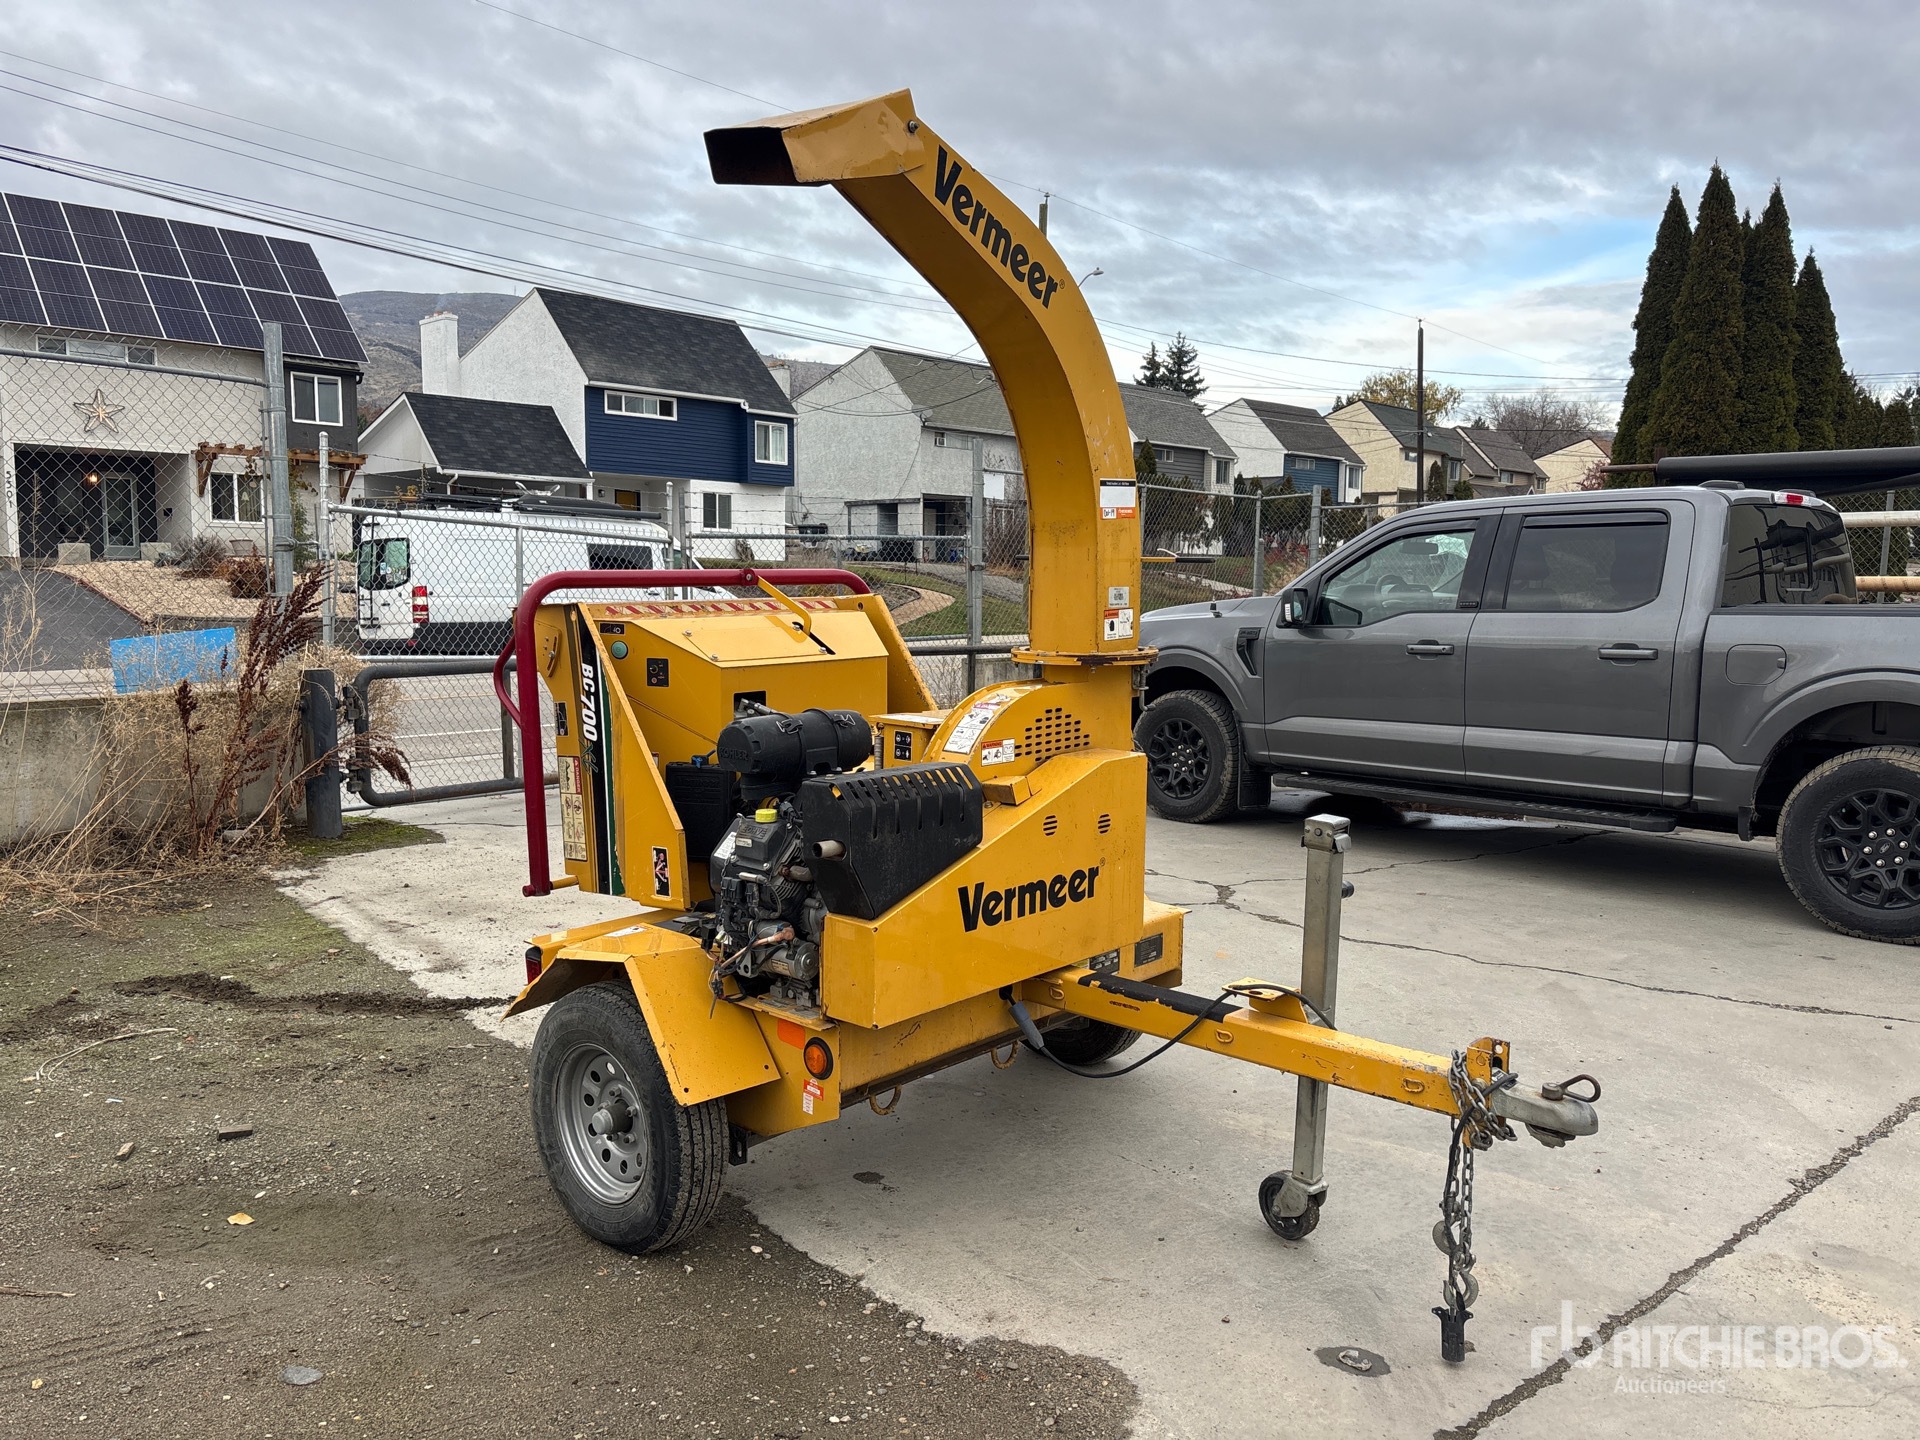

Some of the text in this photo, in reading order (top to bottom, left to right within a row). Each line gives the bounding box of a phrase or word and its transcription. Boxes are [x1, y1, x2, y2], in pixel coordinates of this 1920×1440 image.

[934, 144, 1058, 309] Vermeer
[580, 663, 598, 742] BC700
[719, 746, 748, 761] KOHLER
[957, 866, 1099, 932] Vermeer
